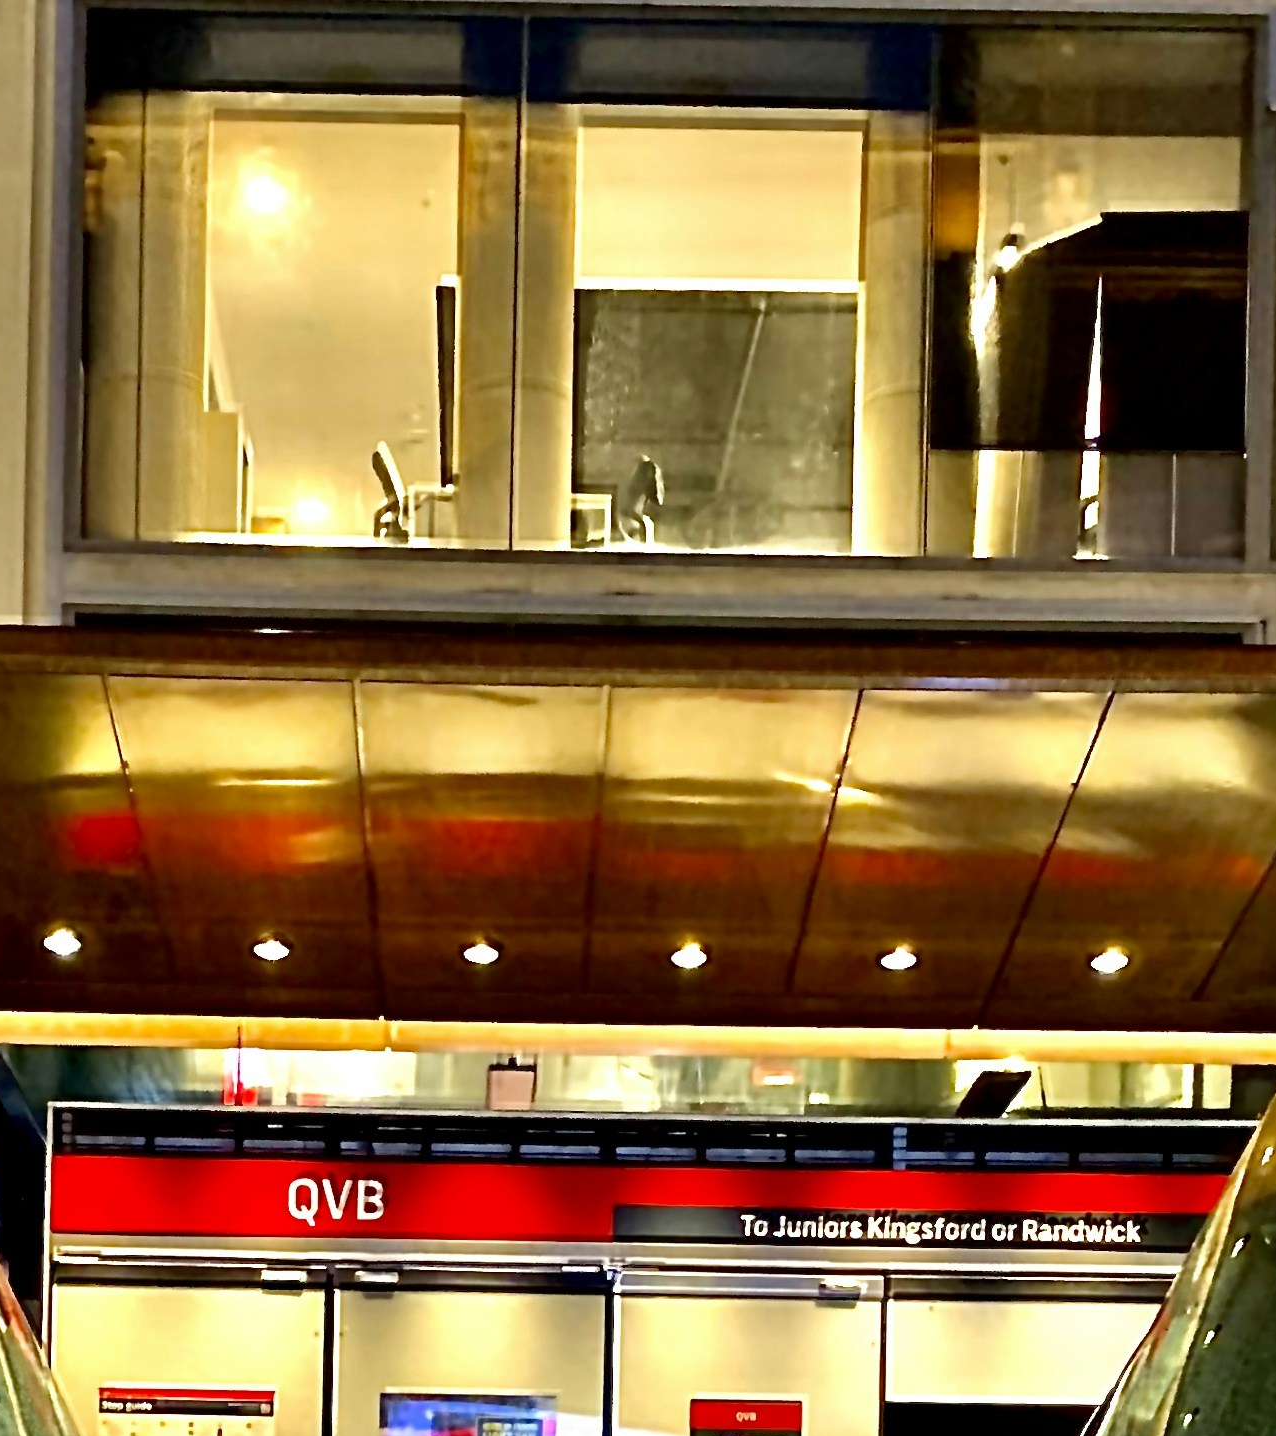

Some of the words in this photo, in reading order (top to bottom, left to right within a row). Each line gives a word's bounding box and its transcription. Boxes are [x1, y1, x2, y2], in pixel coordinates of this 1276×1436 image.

[287, 1177, 385, 1227] QVB
[740, 1214, 769, 1238] To
[773, 1214, 863, 1239] Juniors
[866, 1217, 987, 1245] Kingsford
[991, 1223, 1018, 1241] or
[1022, 1218, 1142, 1244] Randwick
